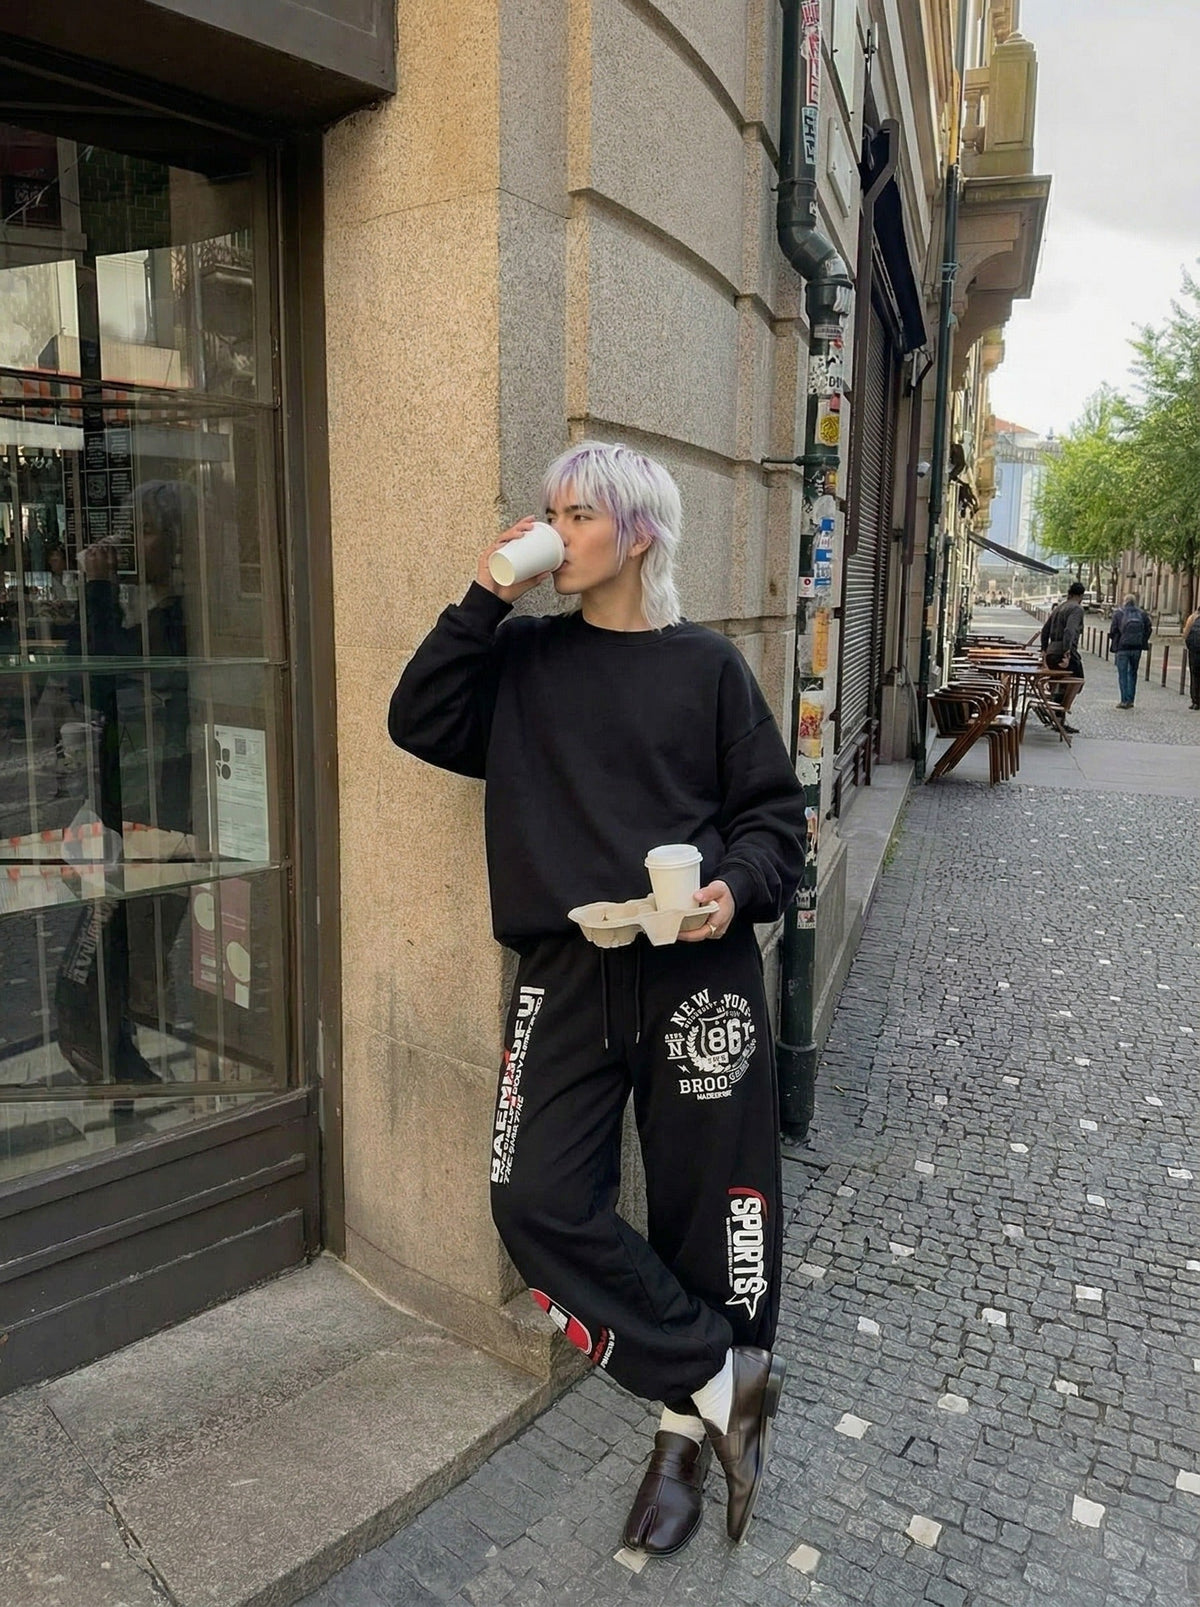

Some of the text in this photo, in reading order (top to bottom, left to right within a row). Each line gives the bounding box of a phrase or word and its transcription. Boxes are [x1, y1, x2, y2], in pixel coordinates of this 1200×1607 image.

[670, 988, 710, 1028] NEW
[707, 1018, 742, 1055] 86
[730, 1197, 764, 1294] SPORTS
